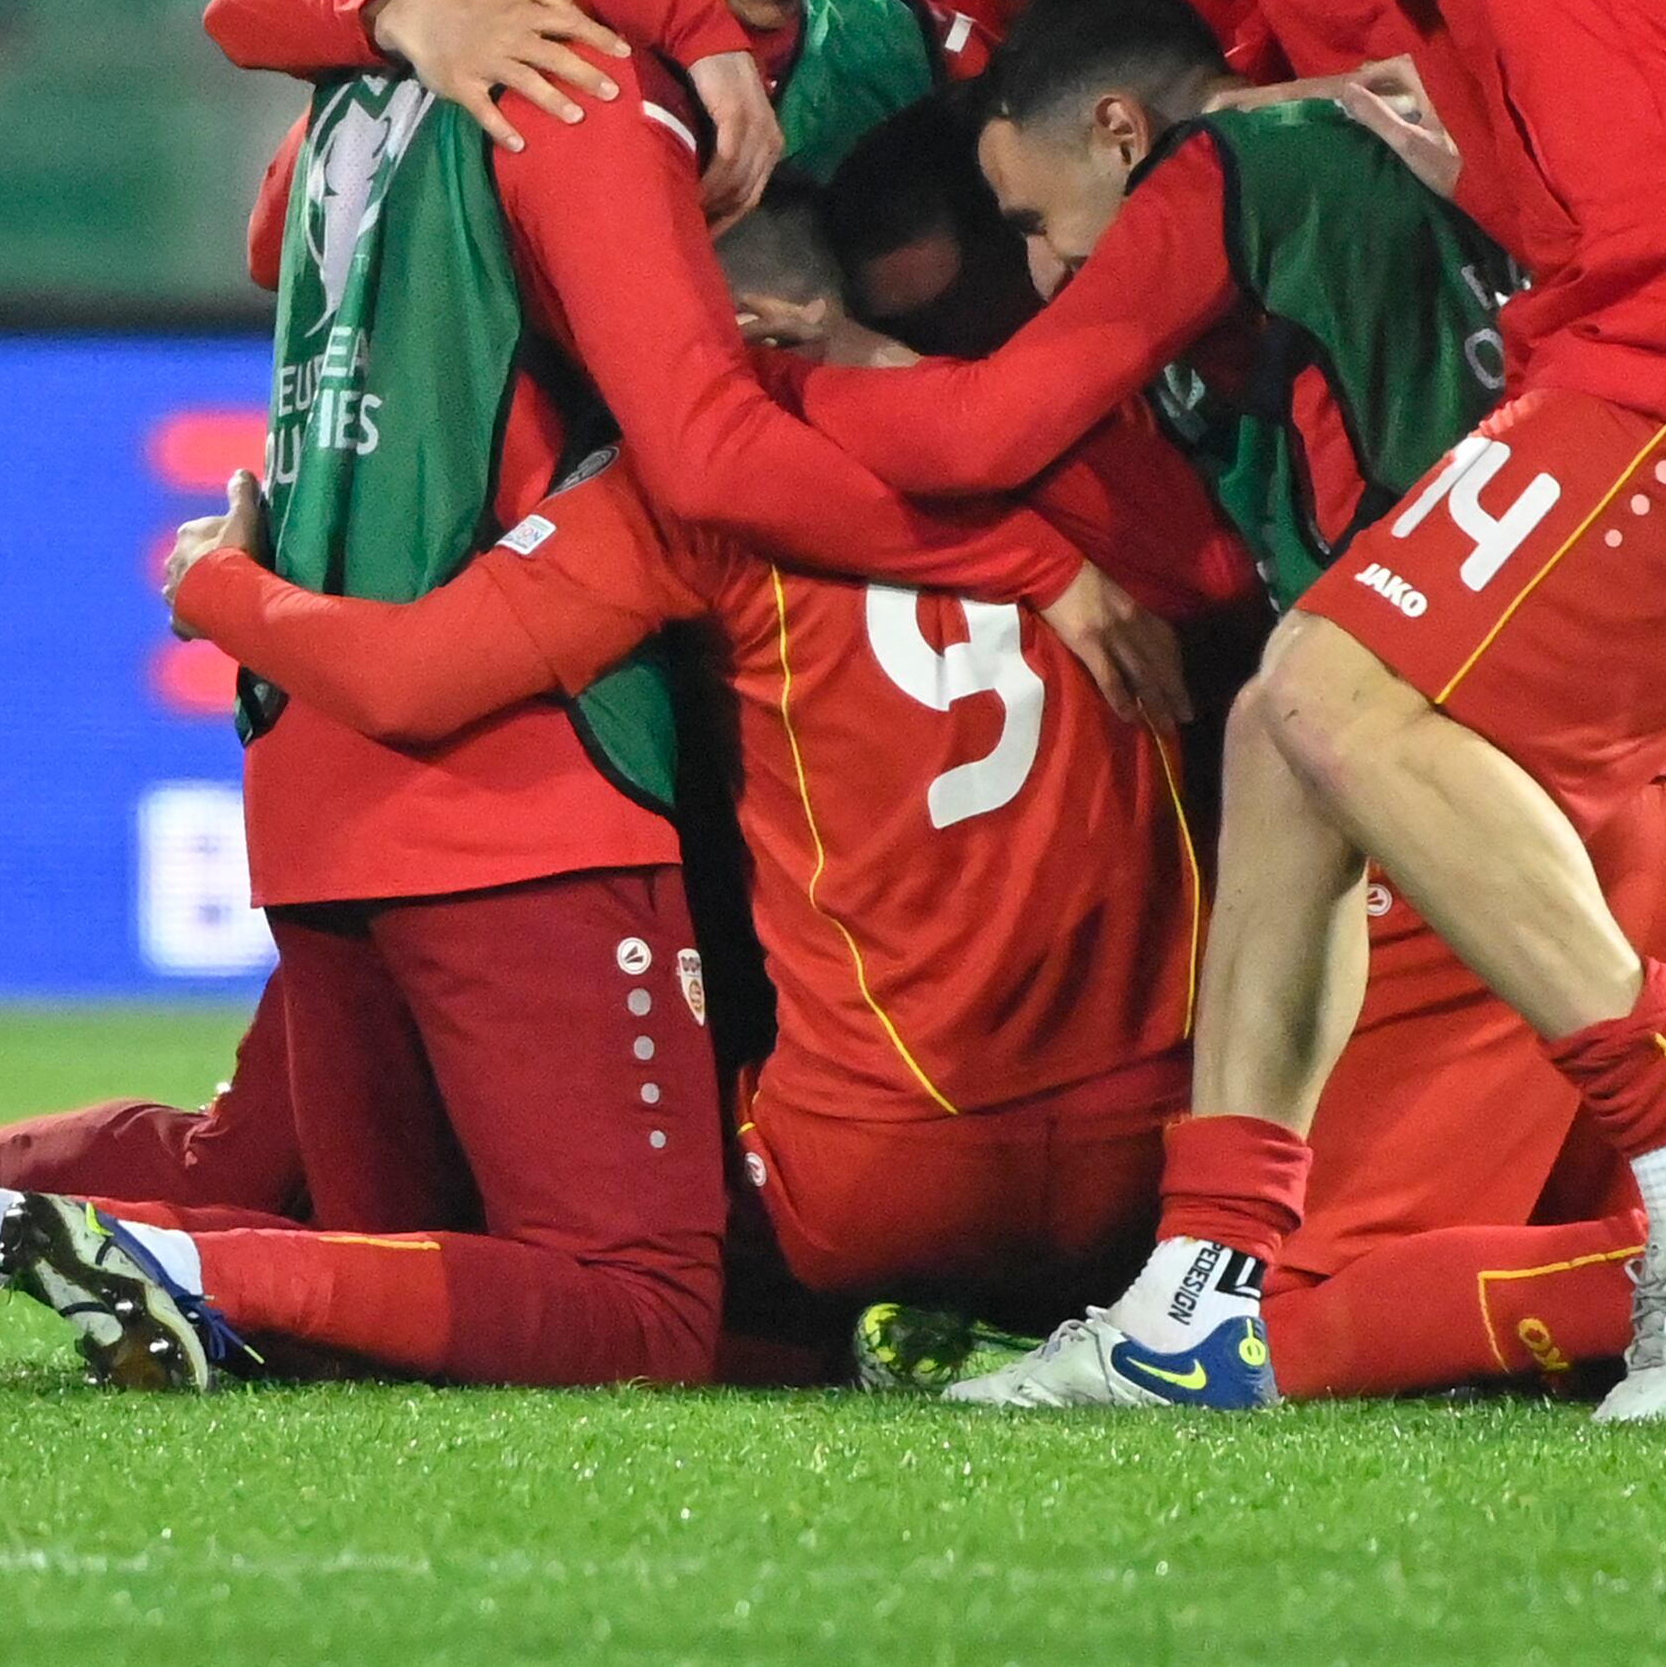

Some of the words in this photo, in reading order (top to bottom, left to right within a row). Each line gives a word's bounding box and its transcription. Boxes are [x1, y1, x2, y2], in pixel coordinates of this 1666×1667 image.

[1354, 563, 1428, 617] JAKO
[1391, 436, 1561, 592] 14
[866, 583, 1045, 829] 9
